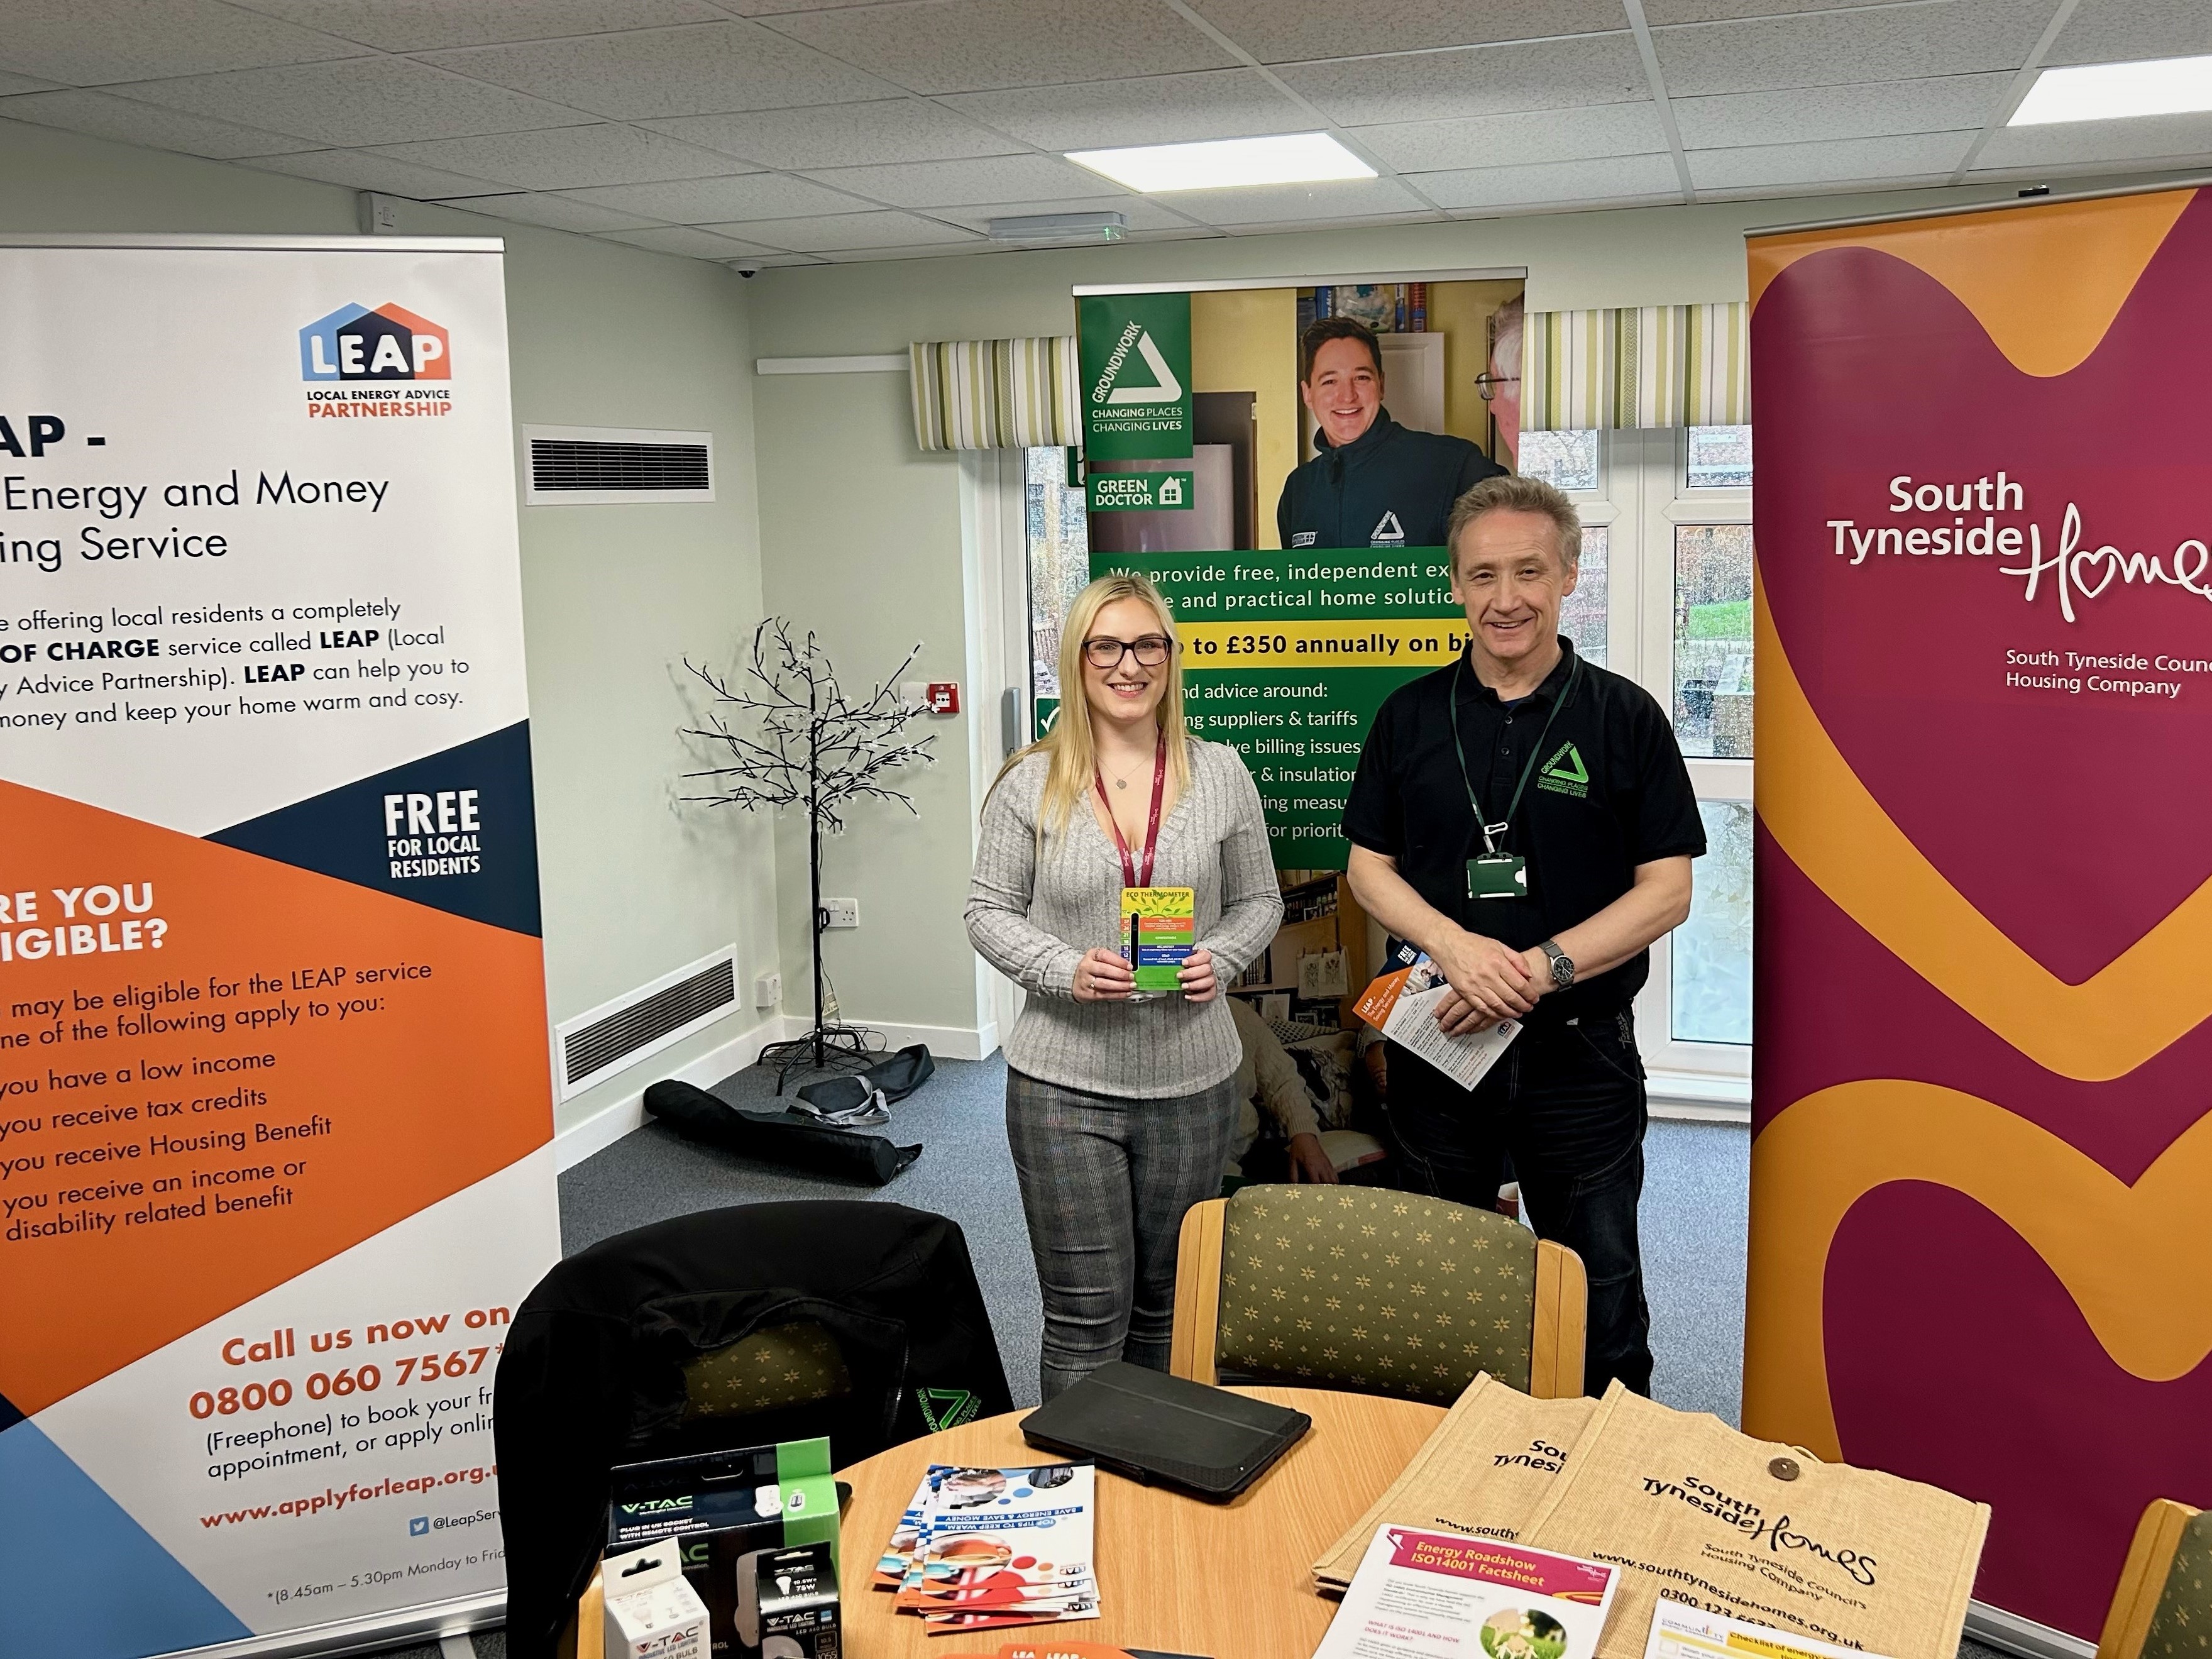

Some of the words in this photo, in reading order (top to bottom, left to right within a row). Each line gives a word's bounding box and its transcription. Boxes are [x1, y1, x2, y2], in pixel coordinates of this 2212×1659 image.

[311, 334, 444, 374] LEAP
[1092, 320, 1142, 403] GROUNDWORK
[307, 391, 348, 400] LOCAL
[352, 390, 400, 399] ENERGY
[405, 390, 449, 399] ADVICE
[309, 402, 451, 417] PARTNERSHIP
[1092, 409, 1145, 418] CHANGING
[1147, 407, 1182, 416] PLACES
[1093, 422, 1150, 432] CHANGING
[1153, 421, 1182, 430] LIVES
[4, 477, 147, 519] Energy
[165, 470, 238, 507] and
[256, 471, 388, 512] Money
[1096, 493, 1153, 505] DOCTOR
[1098, 480, 1147, 493] GREEN
[1890, 472, 2023, 512] South
[81, 527, 227, 560] Service
[1150, 566, 1226, 586] provide
[1234, 565, 1279, 582] free,
[1288, 562, 1418, 583] independent
[1827, 517, 2023, 565] Tyneside
[1999, 503, 2212, 622] Home
[18, 610, 102, 633] offering
[112, 606, 162, 626] local
[172, 604, 263, 624] residents
[293, 597, 400, 623] completely
[1182, 592, 1216, 608] and
[1226, 590, 1311, 610] practical
[1321, 590, 1375, 605] home
[0, 644, 36, 663] OF
[48, 639, 159, 661] CHARGE
[169, 638, 241, 656] service
[250, 631, 311, 652] called
[321, 630, 378, 649] LEAP
[389, 626, 444, 651] (Local
[1193, 639, 1217, 654] to
[1227, 636, 1286, 654] £350
[1296, 634, 1399, 656] annually
[1409, 639, 1438, 651] on
[2007, 650, 2059, 666] South
[2065, 653, 2148, 671] Tyneside
[17, 674, 93, 694] Advice
[102, 667, 234, 691] Partnership).
[245, 664, 304, 683] LEAP
[358, 659, 400, 681] help
[1204, 683, 1258, 698] advice
[1263, 683, 1327, 697] around:
[2007, 672, 2080, 693] Housing
[2088, 676, 2181, 698] Company
[126, 702, 177, 724] keep
[185, 704, 231, 723] your
[239, 696, 295, 714] home
[303, 698, 360, 710] warm
[415, 693, 463, 709] cosy.
[1209, 711, 1283, 729] suppliers
[1289, 711, 1302, 725] &
[1307, 711, 1357, 725] tariffs
[1256, 739, 1305, 756] billing
[1311, 739, 1360, 753] issues
[1541, 741, 1574, 773] GROUNDWORK
[1538, 783, 1568, 793] CHANGING
[385, 790, 480, 836] FREE
[388, 839, 422, 857] FOR
[427, 835, 480, 854] LOCAL
[390, 856, 480, 878] RESIDENTS
[52, 883, 152, 918] YOU
[13, 1000, 64, 1020] may
[113, 980, 200, 1010] eligible
[292, 967, 346, 989] LEAP
[356, 962, 431, 983] service
[1362, 998, 1373, 1013] LEAP
[1373, 997, 1385, 1011] Energy
[1387, 976, 1400, 991] Money
[117, 1011, 225, 1036] following
[235, 1000, 300, 1029] apply
[1373, 1008, 1385, 1021] Saving
[1382, 995, 1394, 1008] Service
[141, 1060, 182, 1080] low
[192, 1055, 275, 1074] income
[147, 1101, 184, 1118] tax
[192, 1087, 267, 1112] credits
[150, 1131, 245, 1155] Housing
[256, 1115, 331, 1142] Benefit
[192, 1166, 274, 1188] income
[6, 1210, 116, 1241] disability
[126, 1196, 205, 1225] related
[216, 1185, 292, 1213] benefit
[223, 1328, 294, 1365] Call
[311, 1330, 352, 1352] us
[367, 1315, 450, 1344] now
[465, 1308, 510, 1328] on
[190, 1379, 292, 1419] 0800
[307, 1365, 380, 1399] 060
[207, 1414, 331, 1456] (Freephone)
[368, 1399, 419, 1423] book
[427, 1396, 471, 1419] your
[209, 1441, 346, 1481] appointment,
[385, 1421, 443, 1450] apply
[200, 1465, 497, 1528] www.applyforleap.org.
[621, 1495, 693, 1513] V-TAC
[1683, 1477, 1760, 1516] South
[664, 1518, 693, 1526] SOCKET
[1017, 1509, 1052, 1518] ENERGY
[620, 1532, 640, 1540] WITH
[642, 1528, 672, 1536] REMOTE
[674, 1522, 710, 1531] CONTROL
[1643, 1477, 1754, 1529] Tyneside
[1737, 1515, 1878, 1585] Homes
[351, 1571, 402, 1587] 5.30pm
[409, 1556, 461, 1577] Monday
[1411, 1553, 1475, 1572] ISO14001
[1478, 1564, 1545, 1587] Factsheet
[1416, 1541, 1463, 1558] Energy
[1465, 1548, 1536, 1572] Roadshow
[1701, 1551, 1755, 1572] Housing
[1760, 1568, 1823, 1601] Company
[1705, 1543, 1742, 1558] South
[1748, 1554, 1803, 1584] Tyneside
[1807, 1580, 1867, 1609] Council's
[1592, 1551, 1864, 1651] www.southtynesidehomes.org.uk
[1661, 1588, 1697, 1609] 0300
[767, 1611, 815, 1626] V-TAC
[1365, 1627, 1381, 1636] DOES
[1368, 1620, 1387, 1628] WHAT
[1407, 1627, 1426, 1636] 14001
[636, 1626, 699, 1653] V-TAC
[1730, 1632, 1774, 1650] Checklist
